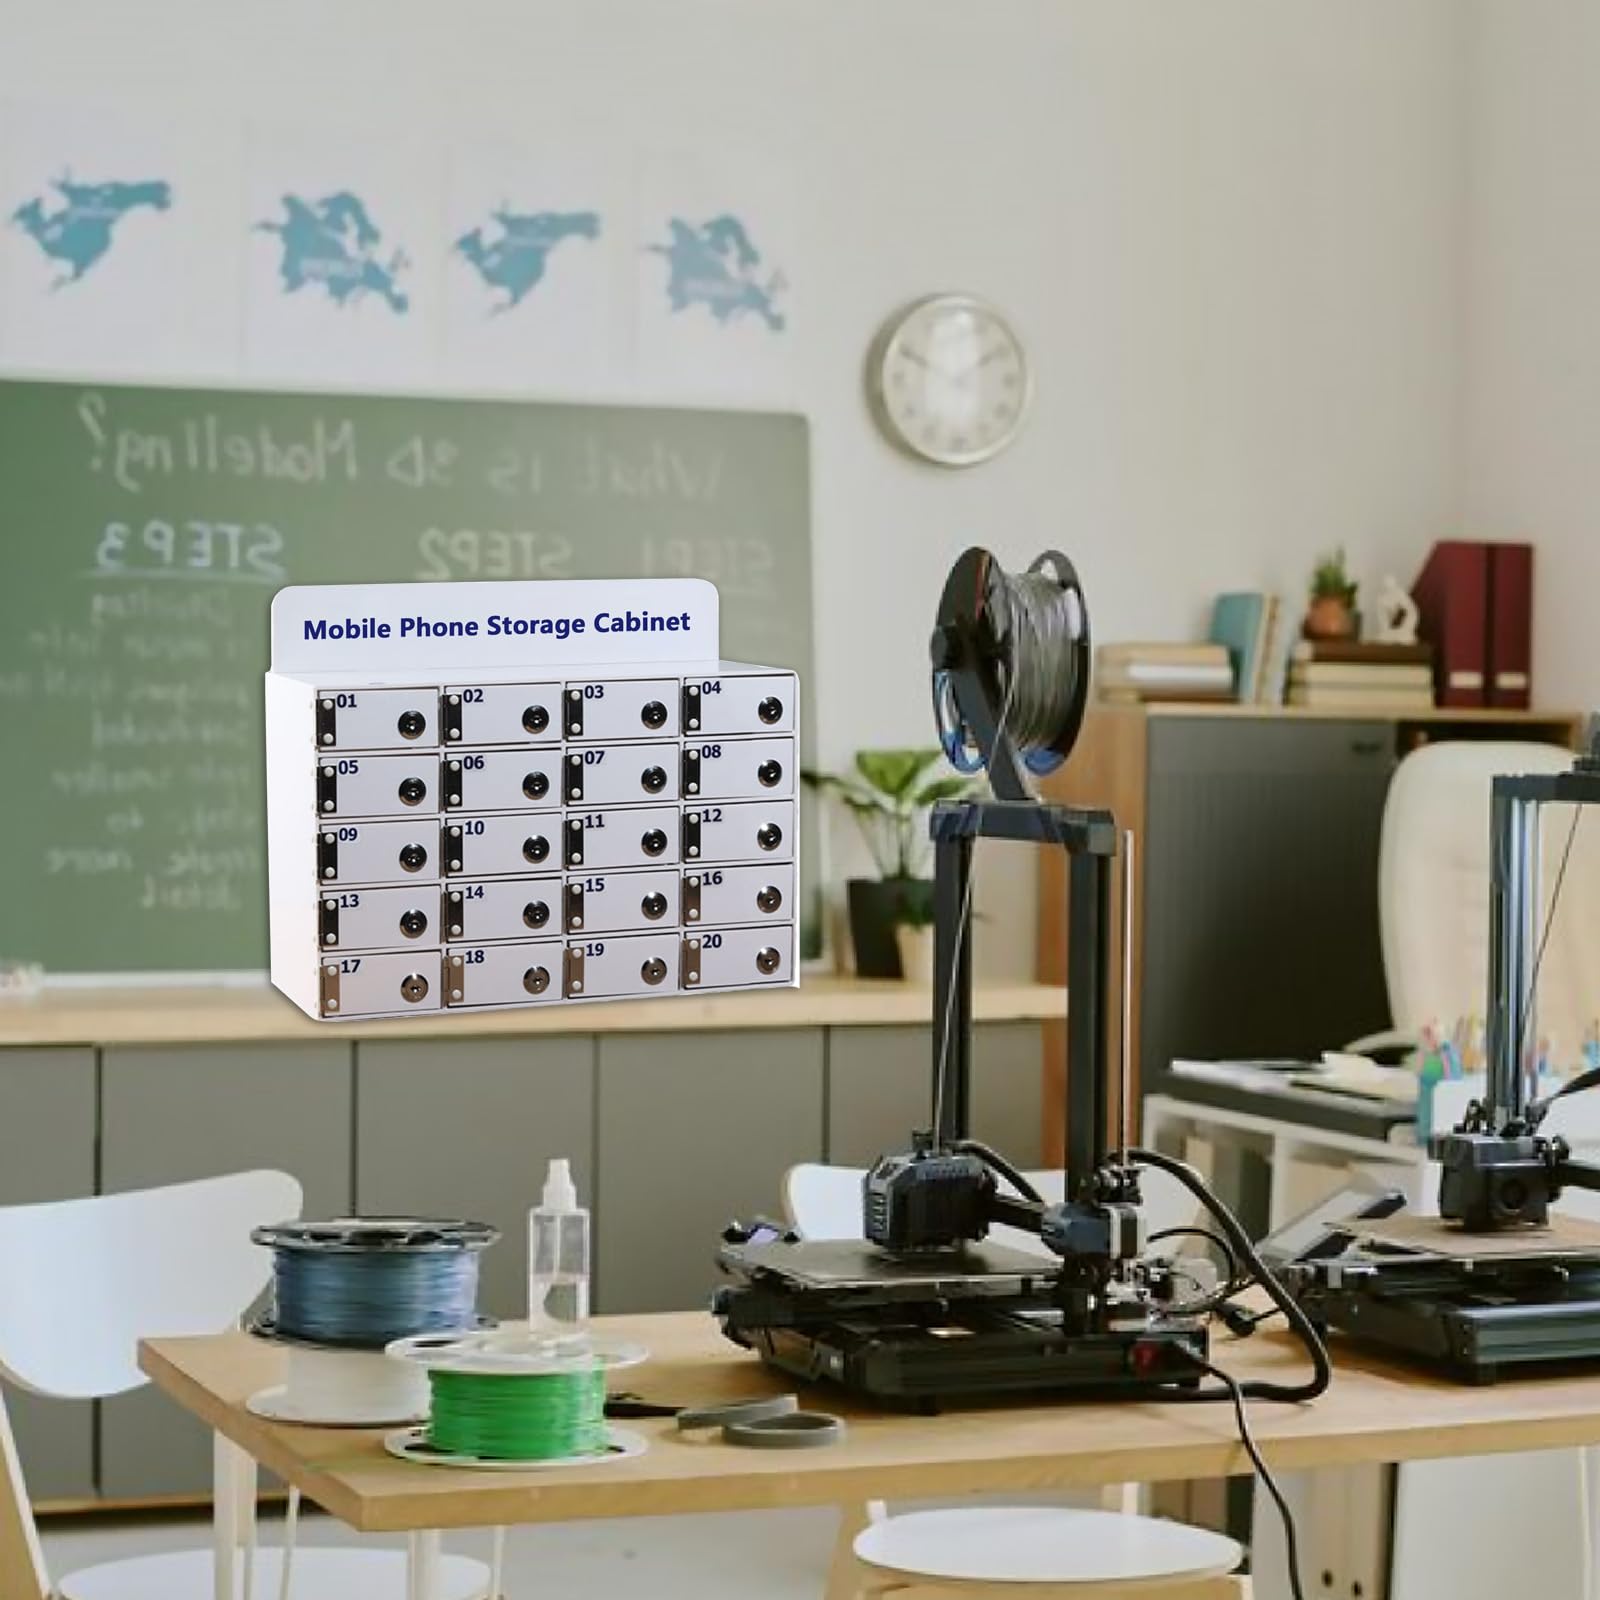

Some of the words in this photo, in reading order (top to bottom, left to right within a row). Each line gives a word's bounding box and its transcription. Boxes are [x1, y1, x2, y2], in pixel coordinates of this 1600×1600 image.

[303, 617, 391, 641] Mobile
[401, 616, 479, 638] Phone
[488, 615, 586, 640] Storage
[594, 610, 691, 633] Cabinet
[464, 689, 483, 703] 02
[585, 685, 604, 699] 03
[702, 681, 721, 694] 04
[337, 694, 357, 708] 01
[585, 747, 605, 764] 07
[702, 741, 723, 758] 08
[338, 757, 358, 774] 05
[464, 755, 484, 770] 06
[585, 811, 605, 828] 11
[703, 809, 722, 822] 12
[338, 824, 357, 841] 09
[465, 818, 484, 835] 10
[585, 875, 604, 892] 15
[703, 868, 723, 885] 16
[465, 882, 484, 899] 14
[340, 891, 359, 908] 13
[586, 943, 604, 956] 19
[703, 934, 722, 949] 20
[465, 947, 484, 964] 18
[341, 956, 360, 973] 17
